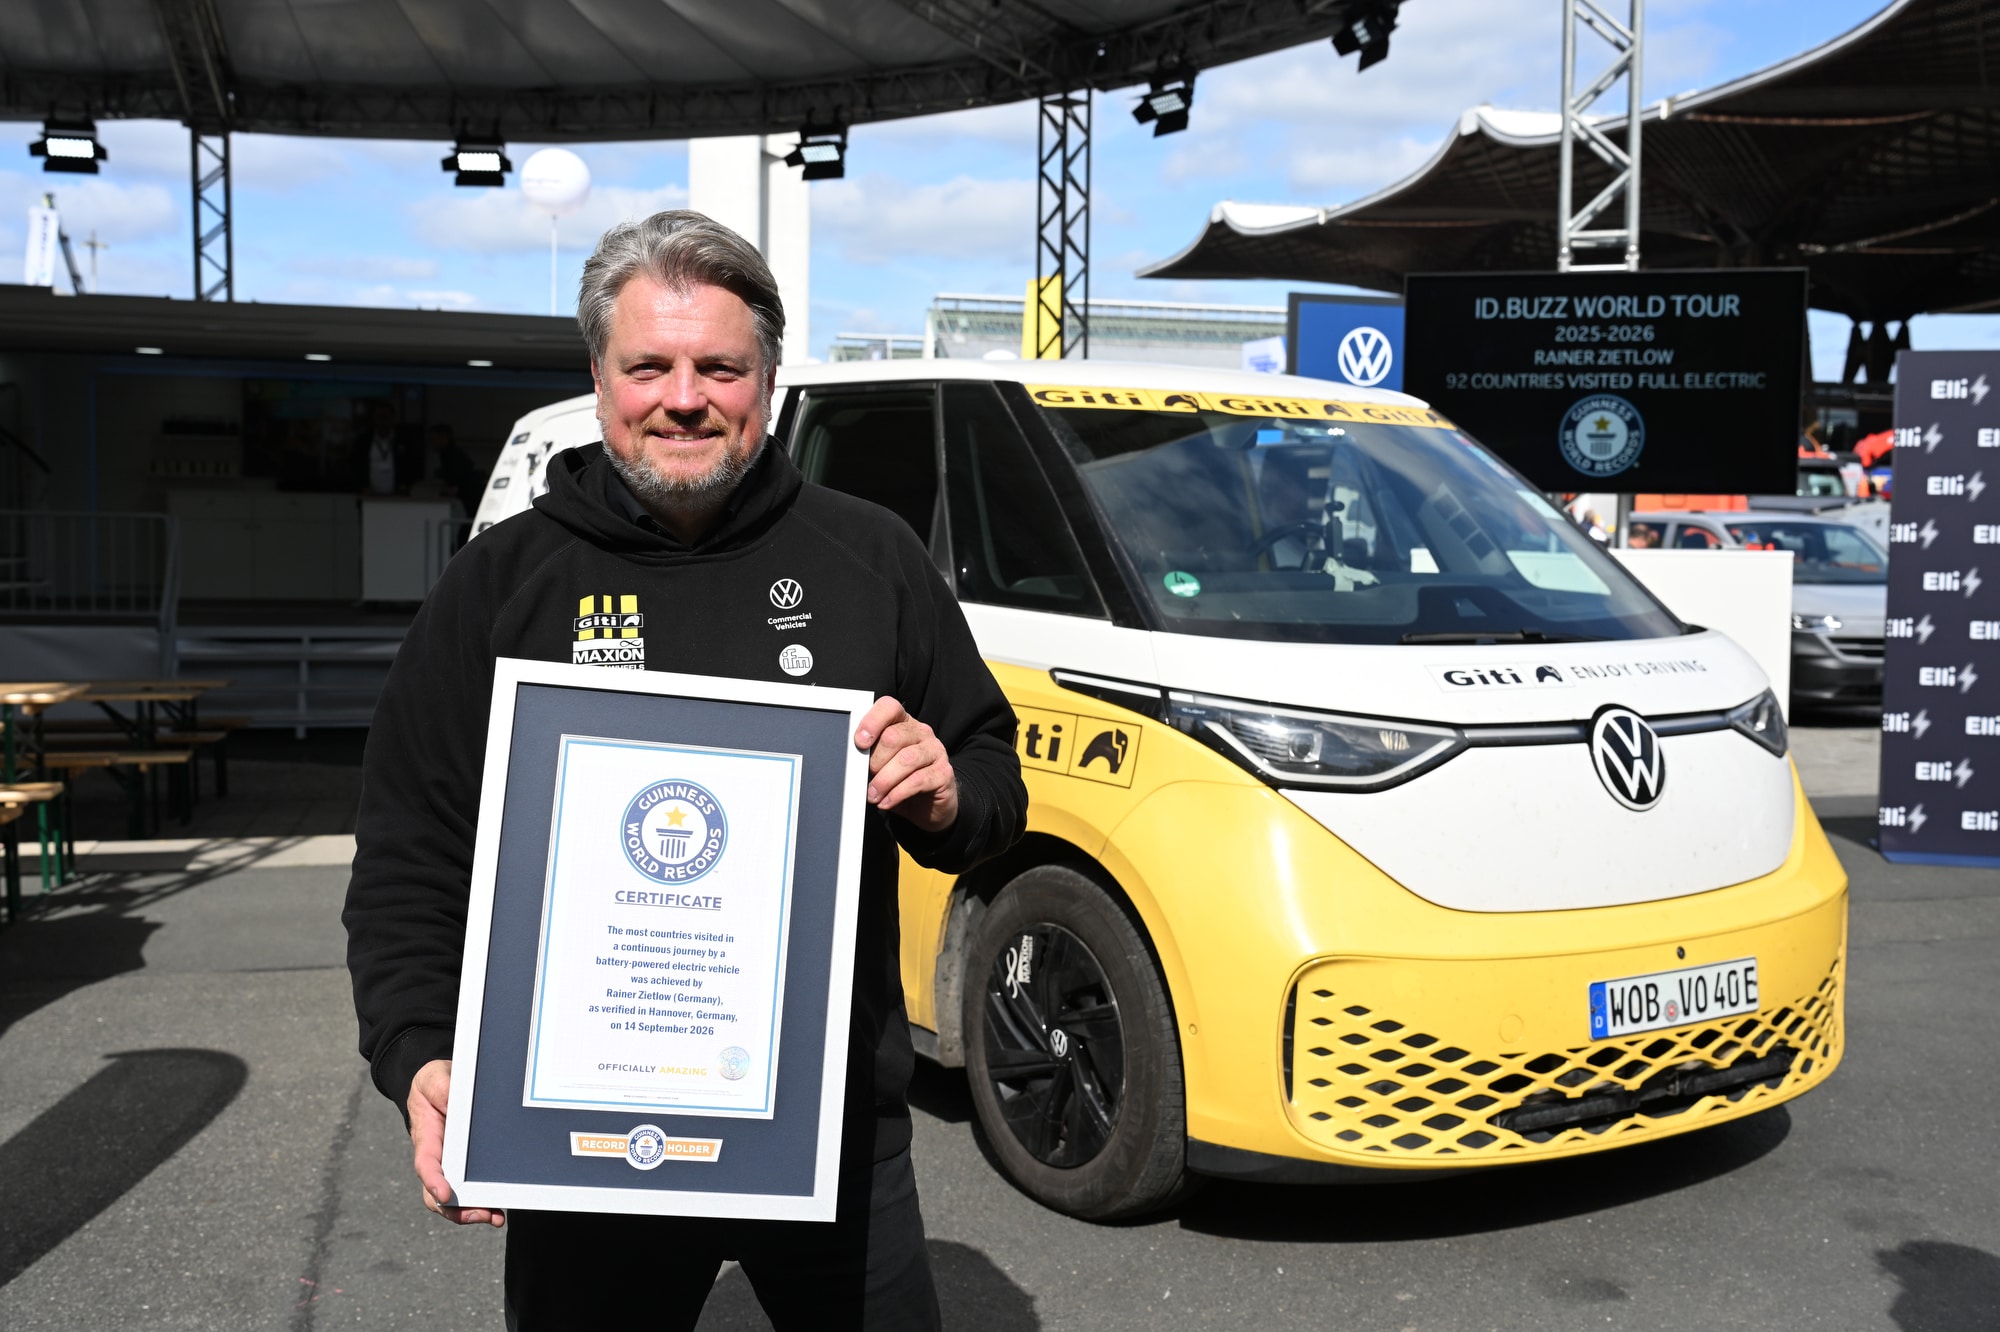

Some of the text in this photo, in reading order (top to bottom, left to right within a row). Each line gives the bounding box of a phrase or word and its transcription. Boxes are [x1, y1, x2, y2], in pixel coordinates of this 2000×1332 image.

[1475, 294, 1740, 319] ID.BUZZ WORLD TOUR
[1554, 325, 1655, 342] 2025-2026
[1534, 349, 1675, 366] RAINER ZIETLOW
[1446, 372, 1767, 389] 92 COUNTRIES VISITED FULL ELECTRIC
[1931, 379, 1968, 399] Elli
[1034, 390, 1142, 405] Giti
[1220, 398, 1309, 415] Giti
[1362, 408, 1424, 424] Giti
[1978, 428, 2000, 447] El
[1564, 429, 1592, 469] WORLD
[1927, 475, 1964, 496] Elli
[1974, 525, 2000, 544] Ell
[1923, 571, 1960, 591] Elli
[578, 616, 617, 628] Giti
[767, 613, 812, 625] Commercial
[775, 621, 807, 631] Vehicles
[1970, 620, 2000, 640] Ell
[573, 648, 645, 664] MAXION
[782, 648, 811, 669] ifm
[1443, 660, 1707, 686] Giti ENJOY DRIVING
[1919, 666, 1956, 687] Elli
[1013, 717, 1063, 762] ti
[1915, 761, 1952, 782] Elli
[638, 785, 715, 815] GUINNESS
[1961, 811, 1999, 831] Elli
[627, 822, 721, 879] WORLD RECORDS
[615, 890, 722, 909] CERTIFICATE
[607, 925, 734, 943] The most countries visited in
[621, 943, 671, 954] continuous
[672, 946, 706, 958] journey
[708, 948, 719, 959] by
[596, 956, 740, 974] battery-powered electric vehicle
[631, 975, 703, 989] was achieved by
[606, 988, 724, 1006] Rainer Zietlow (Germany),
[1610, 982, 1660, 1027] WOB
[601, 1005, 636, 1015] verified
[638, 1006, 647, 1016] in
[648, 1007, 694, 1019] Hannover,
[696, 1010, 738, 1022] Germany,
[1595, 1015, 1604, 1029] D
[610, 1021, 715, 1036] on 14 September 2026
[598, 1063, 708, 1076] OFFICIALLY AMAZING
[582, 1140, 625, 1150] RECORD
[634, 1130, 660, 1142] GUINNESS
[630, 1143, 641, 1162] WORLD
[667, 1144, 710, 1154] HOLDER
